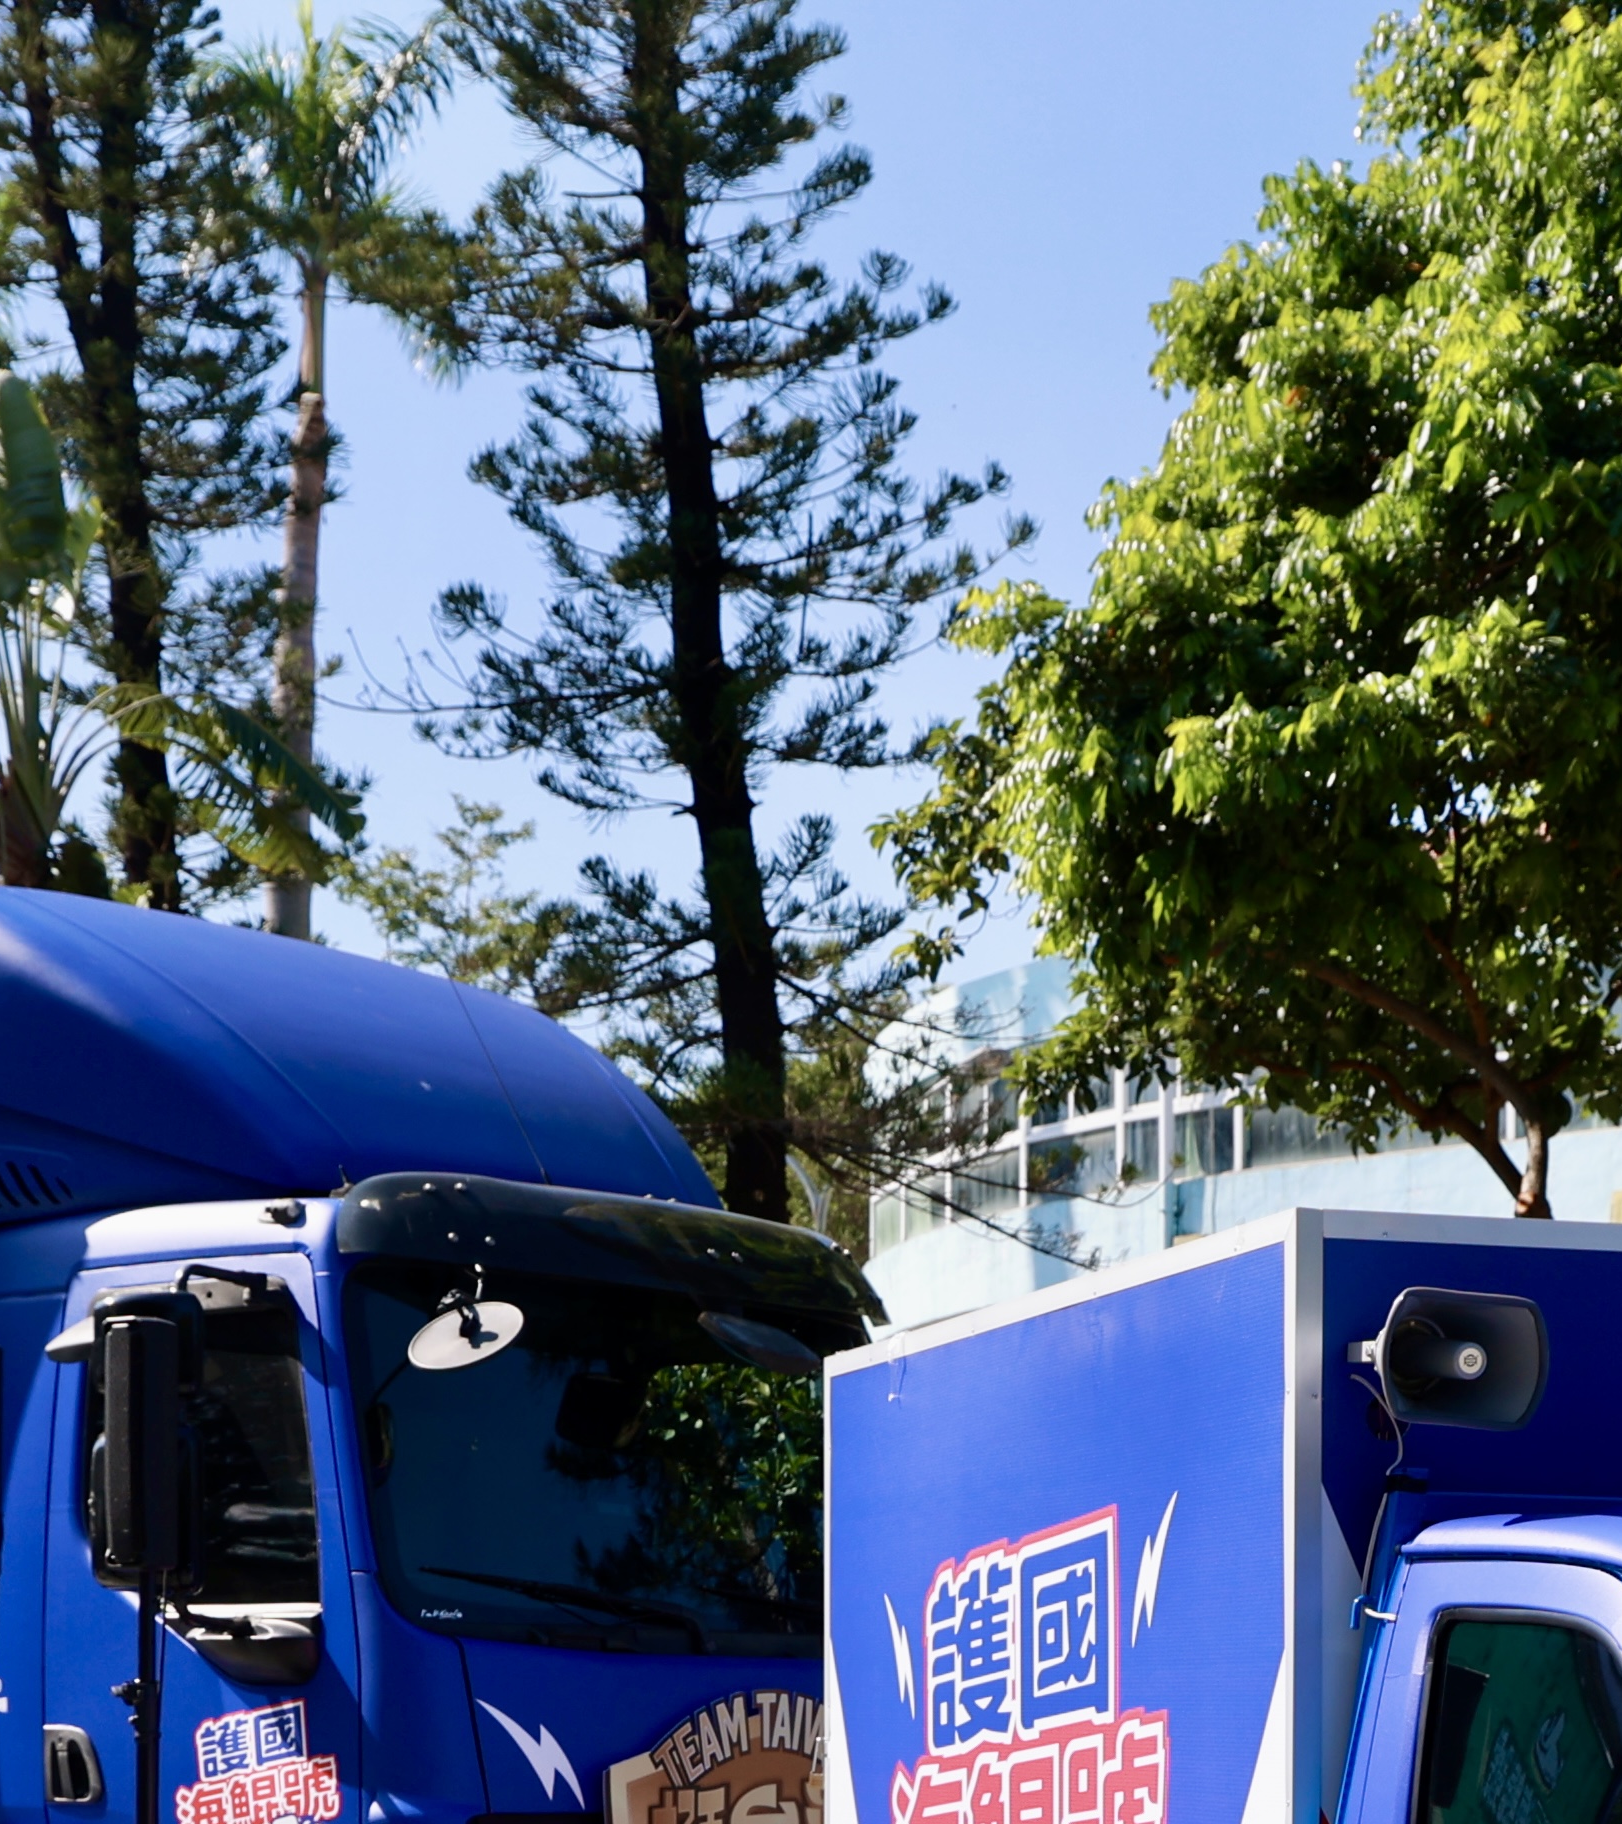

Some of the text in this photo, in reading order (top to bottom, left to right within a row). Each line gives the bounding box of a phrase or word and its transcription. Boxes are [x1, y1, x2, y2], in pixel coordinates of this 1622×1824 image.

[926, 1514, 1116, 1756] 護國
[195, 1700, 307, 1782] 護國
[653, 1692, 753, 1788] TEAM
